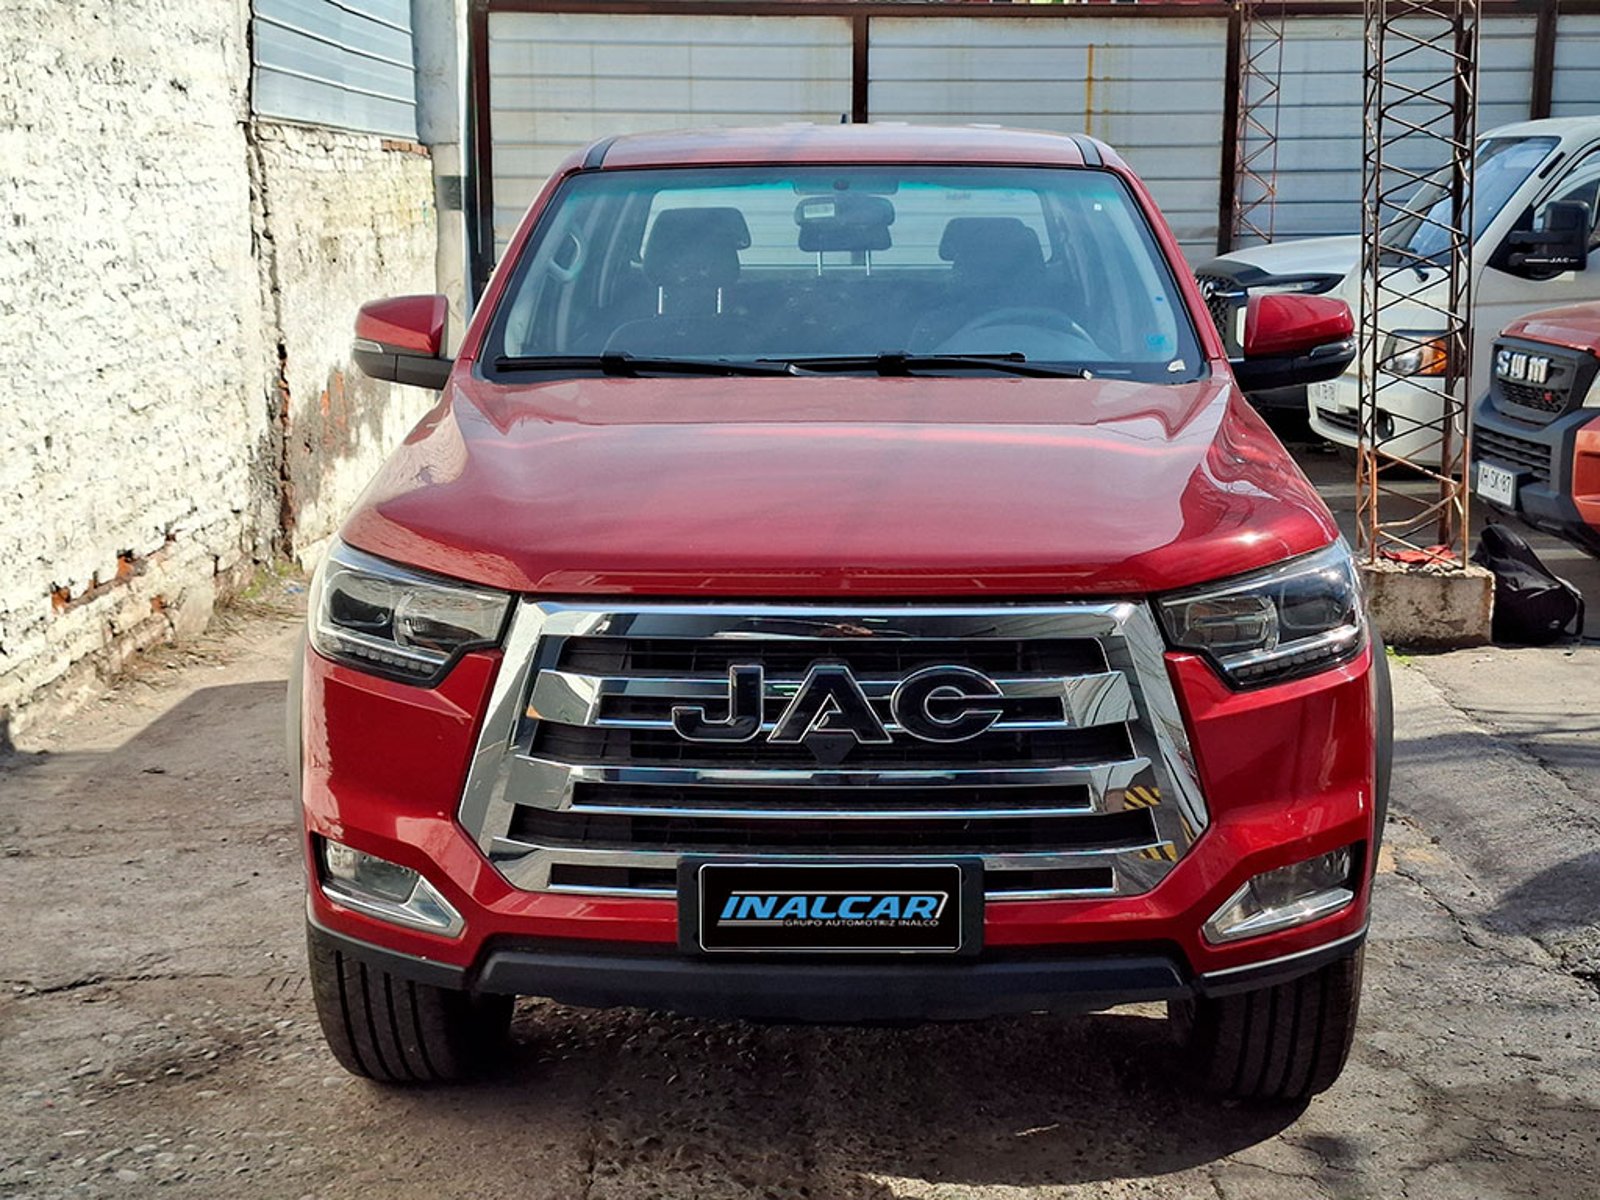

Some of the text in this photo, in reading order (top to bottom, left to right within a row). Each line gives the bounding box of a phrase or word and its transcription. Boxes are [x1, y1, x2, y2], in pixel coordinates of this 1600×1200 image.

[1496, 350, 1549, 384] SWM
[671, 663, 1005, 744] JAC
[720, 895, 939, 919] INALCAR
[784, 919, 940, 928] GRUPO AUTOMOTRIZ INALCO
